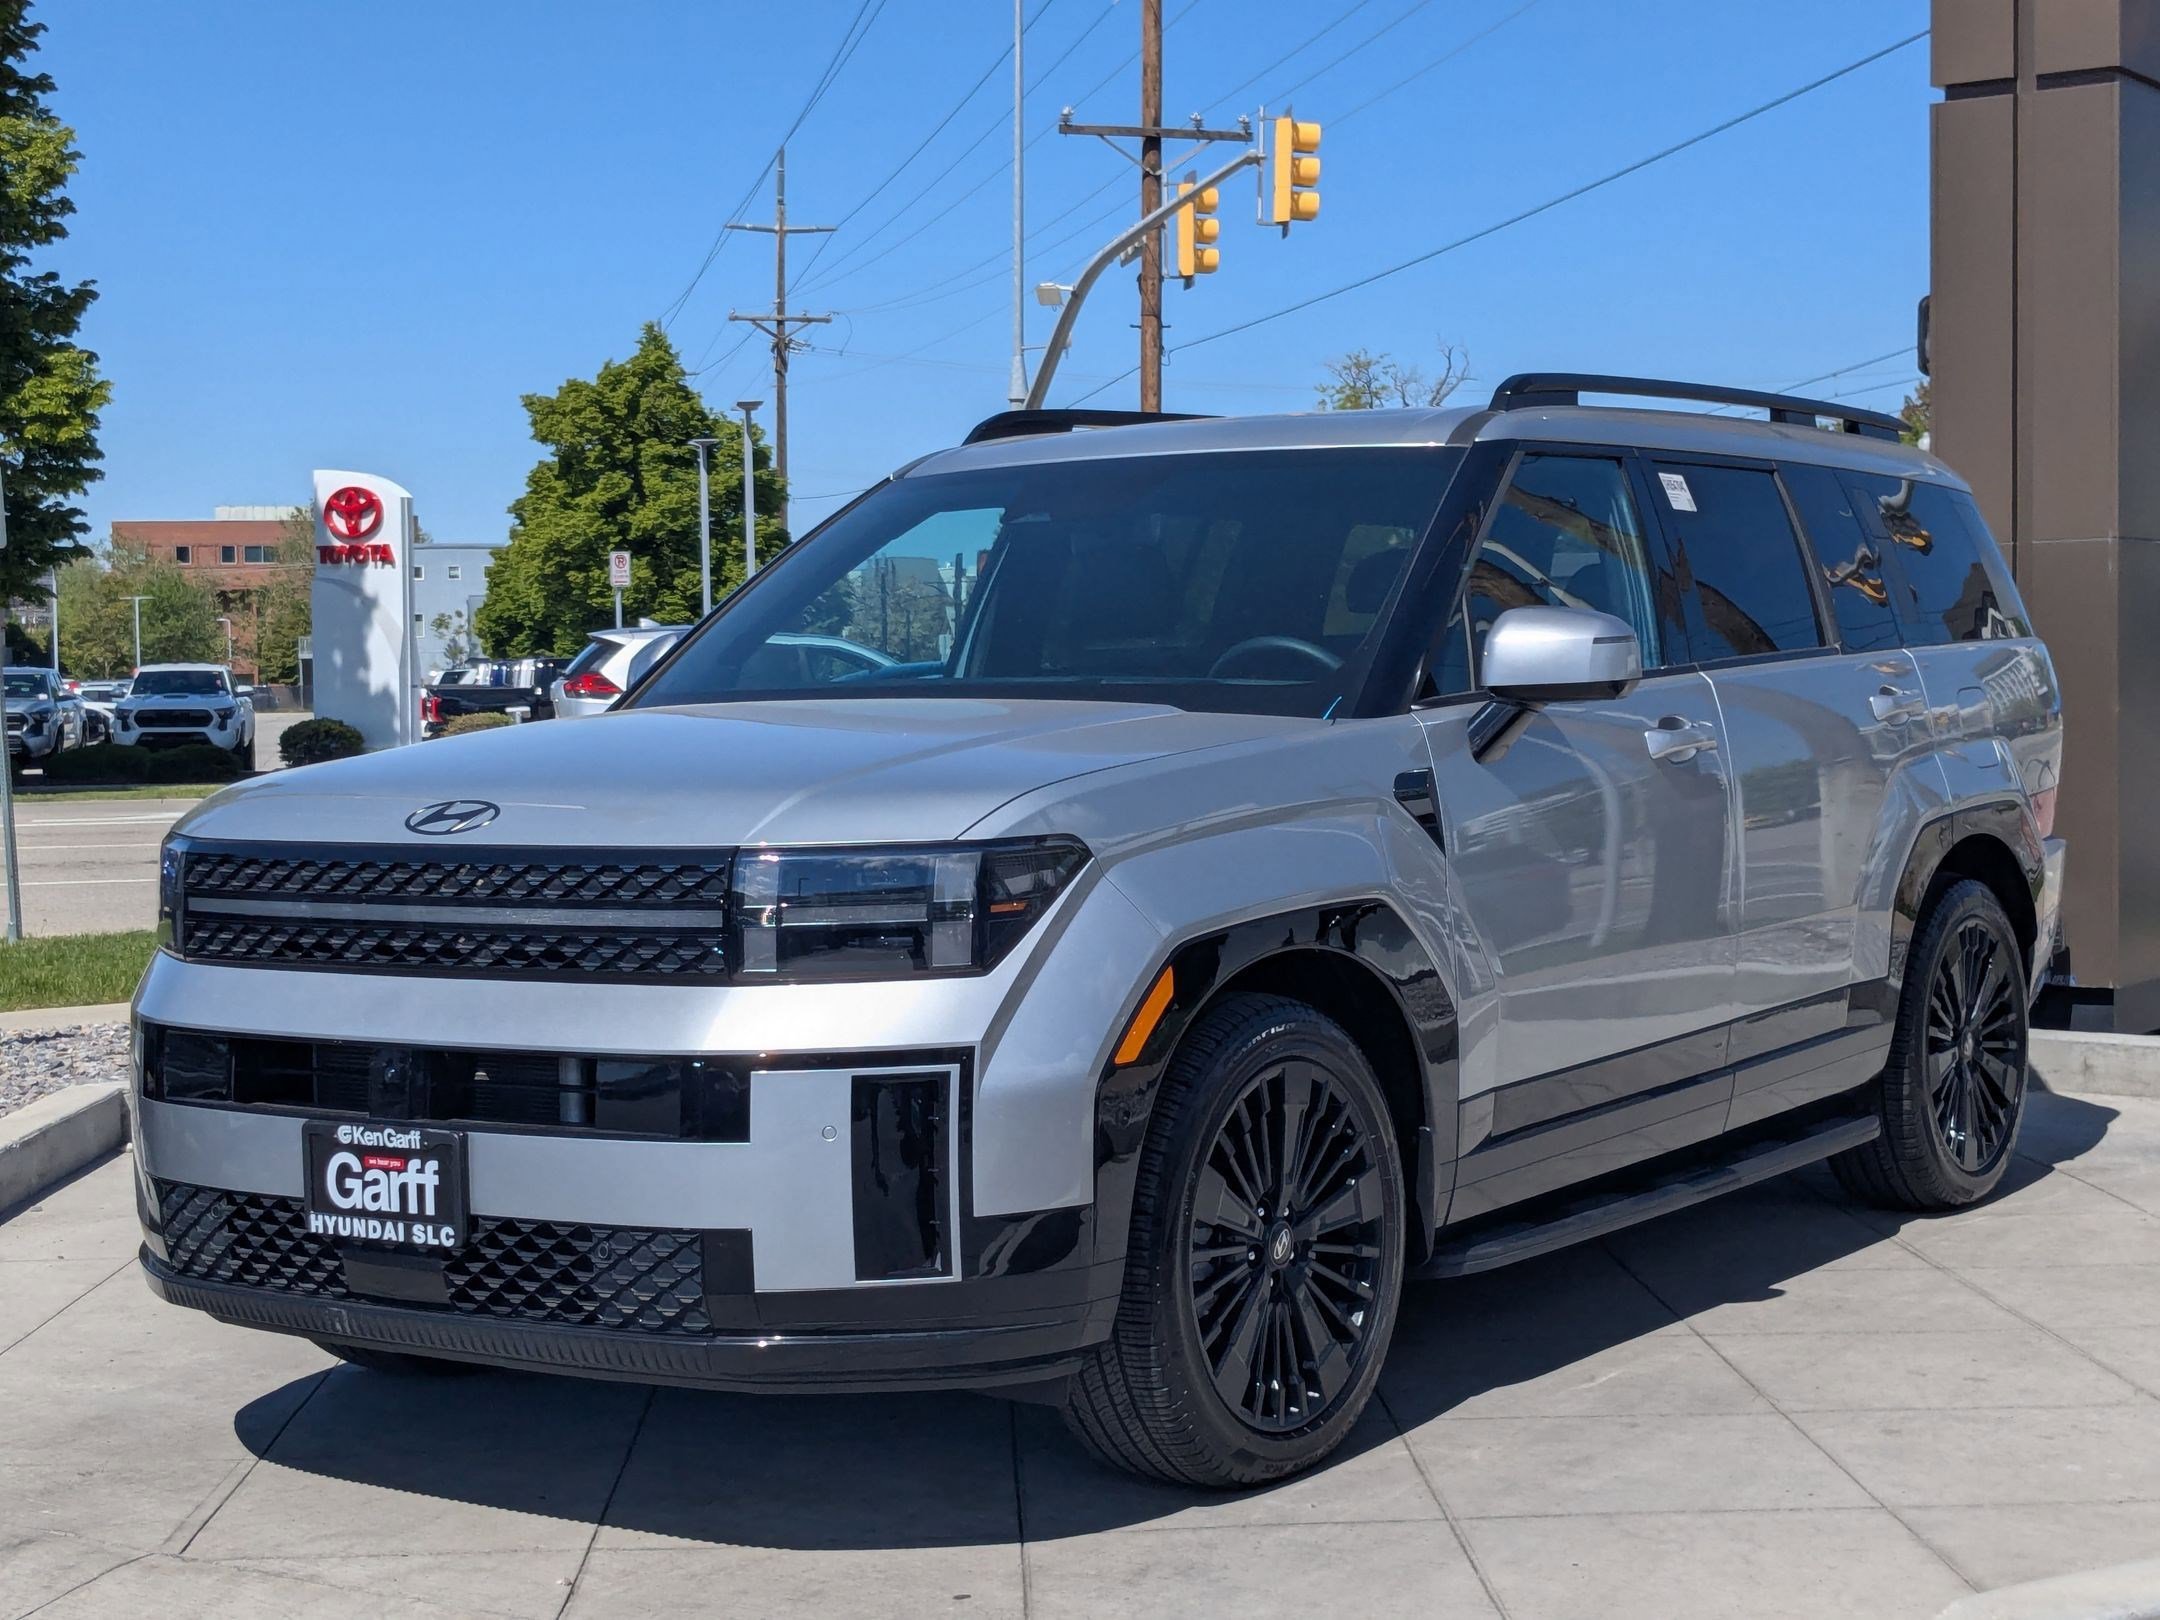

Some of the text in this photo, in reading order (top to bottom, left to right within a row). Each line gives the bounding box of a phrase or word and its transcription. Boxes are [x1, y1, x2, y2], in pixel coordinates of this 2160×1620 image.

[316, 544, 395, 565] TOYOTA
[390, 1160, 401, 1168] you
[327, 1152, 439, 1216] Garff
[310, 1214, 456, 1247] HYUNDAI SLC
